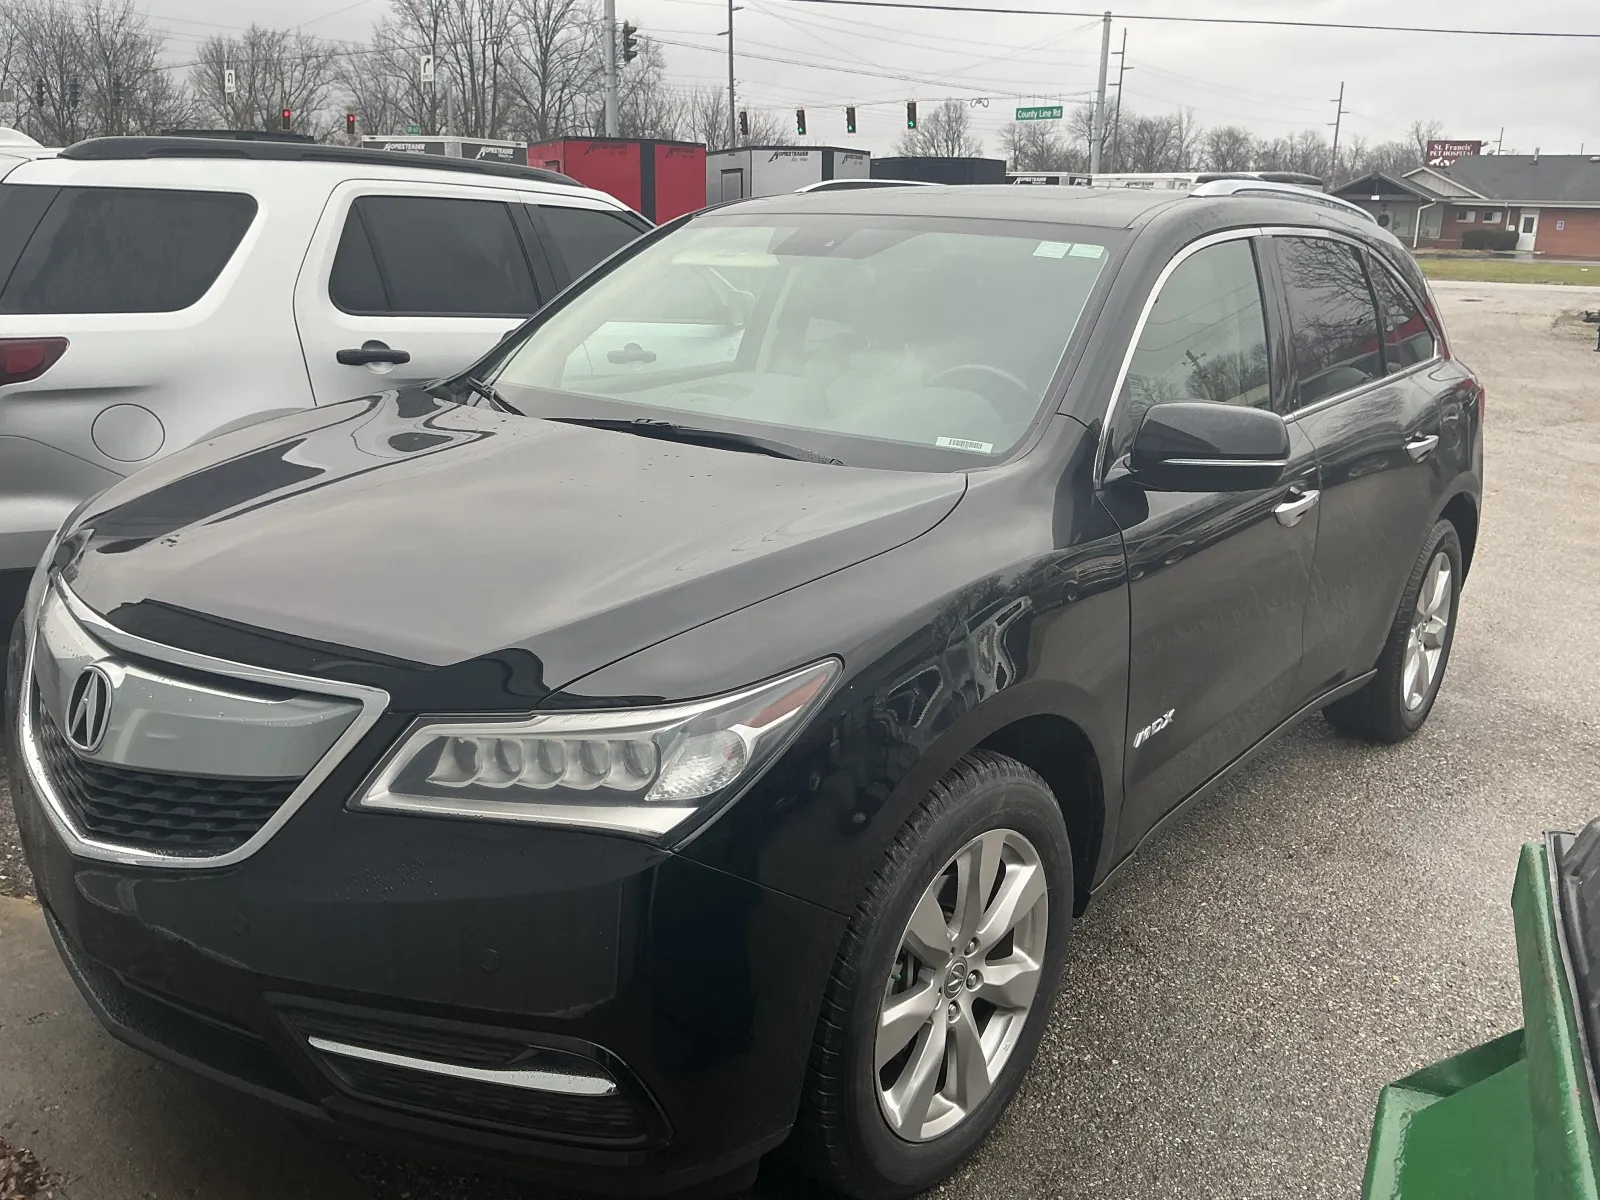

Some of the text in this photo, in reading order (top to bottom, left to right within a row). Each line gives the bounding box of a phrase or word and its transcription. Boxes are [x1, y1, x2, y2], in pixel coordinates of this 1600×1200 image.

[1018, 108, 1062, 120] County Line Rd
[1433, 143, 1443, 151] St.
[1132, 708, 1176, 748] MDX
